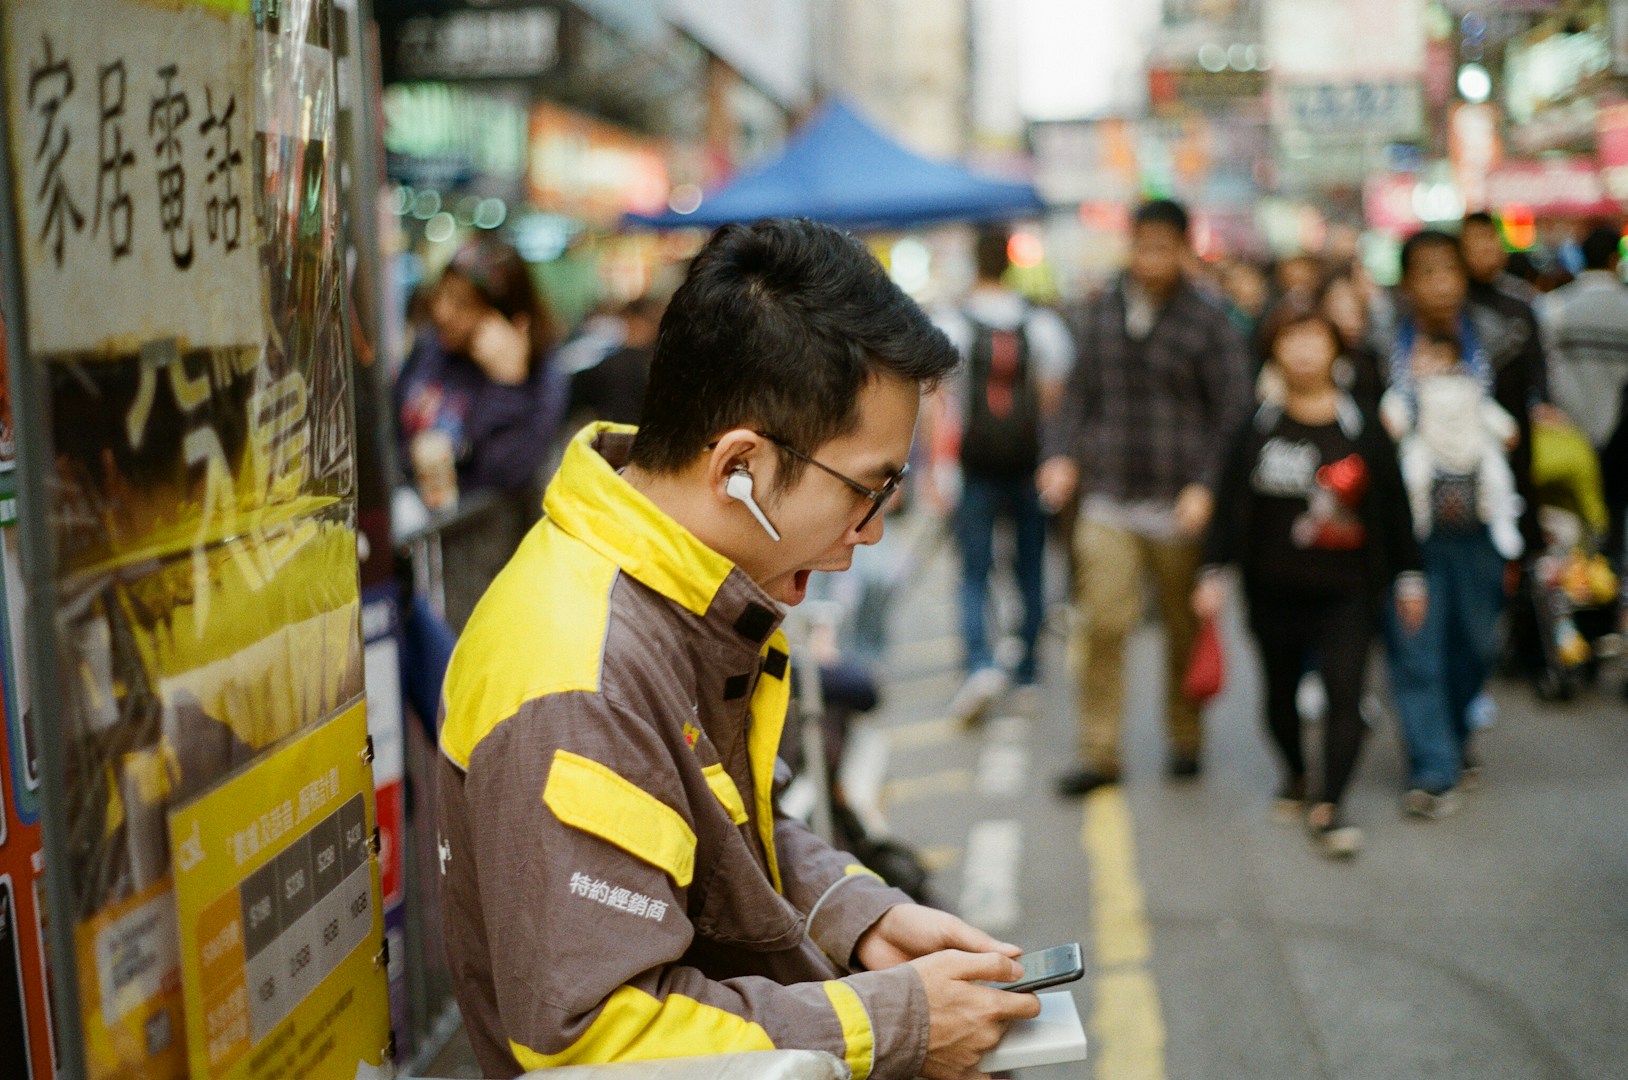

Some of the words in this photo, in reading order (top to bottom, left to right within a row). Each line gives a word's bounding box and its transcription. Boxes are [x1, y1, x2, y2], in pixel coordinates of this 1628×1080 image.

[28, 31, 243, 271] 家居電話
[569, 872, 669, 921] 特約經銷商
